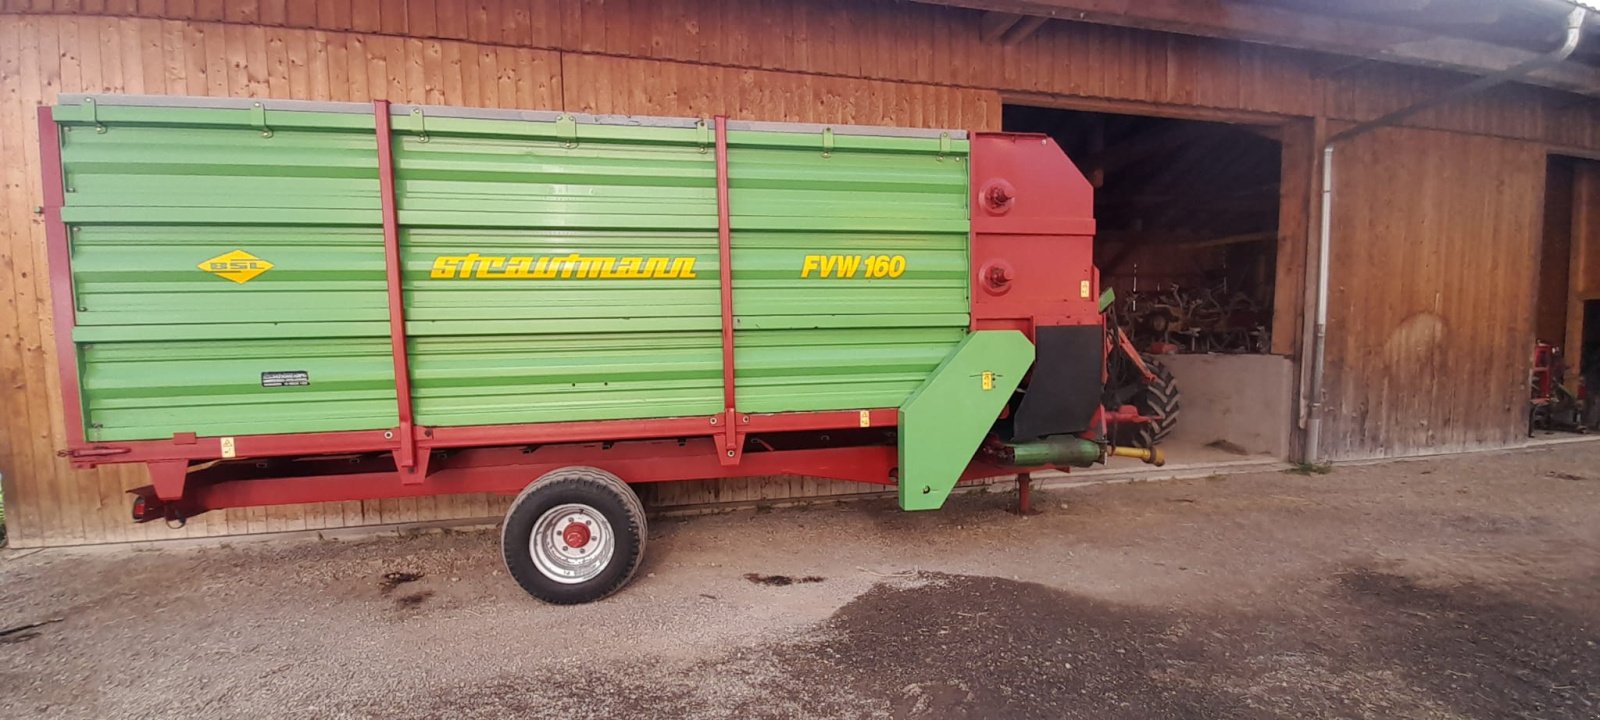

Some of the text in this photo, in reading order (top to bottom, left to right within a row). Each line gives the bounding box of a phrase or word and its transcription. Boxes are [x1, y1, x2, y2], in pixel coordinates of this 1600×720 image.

[209, 260, 265, 273] BSL
[430, 253, 697, 279] strautmann
[801, 255, 906, 278] FVW 160
